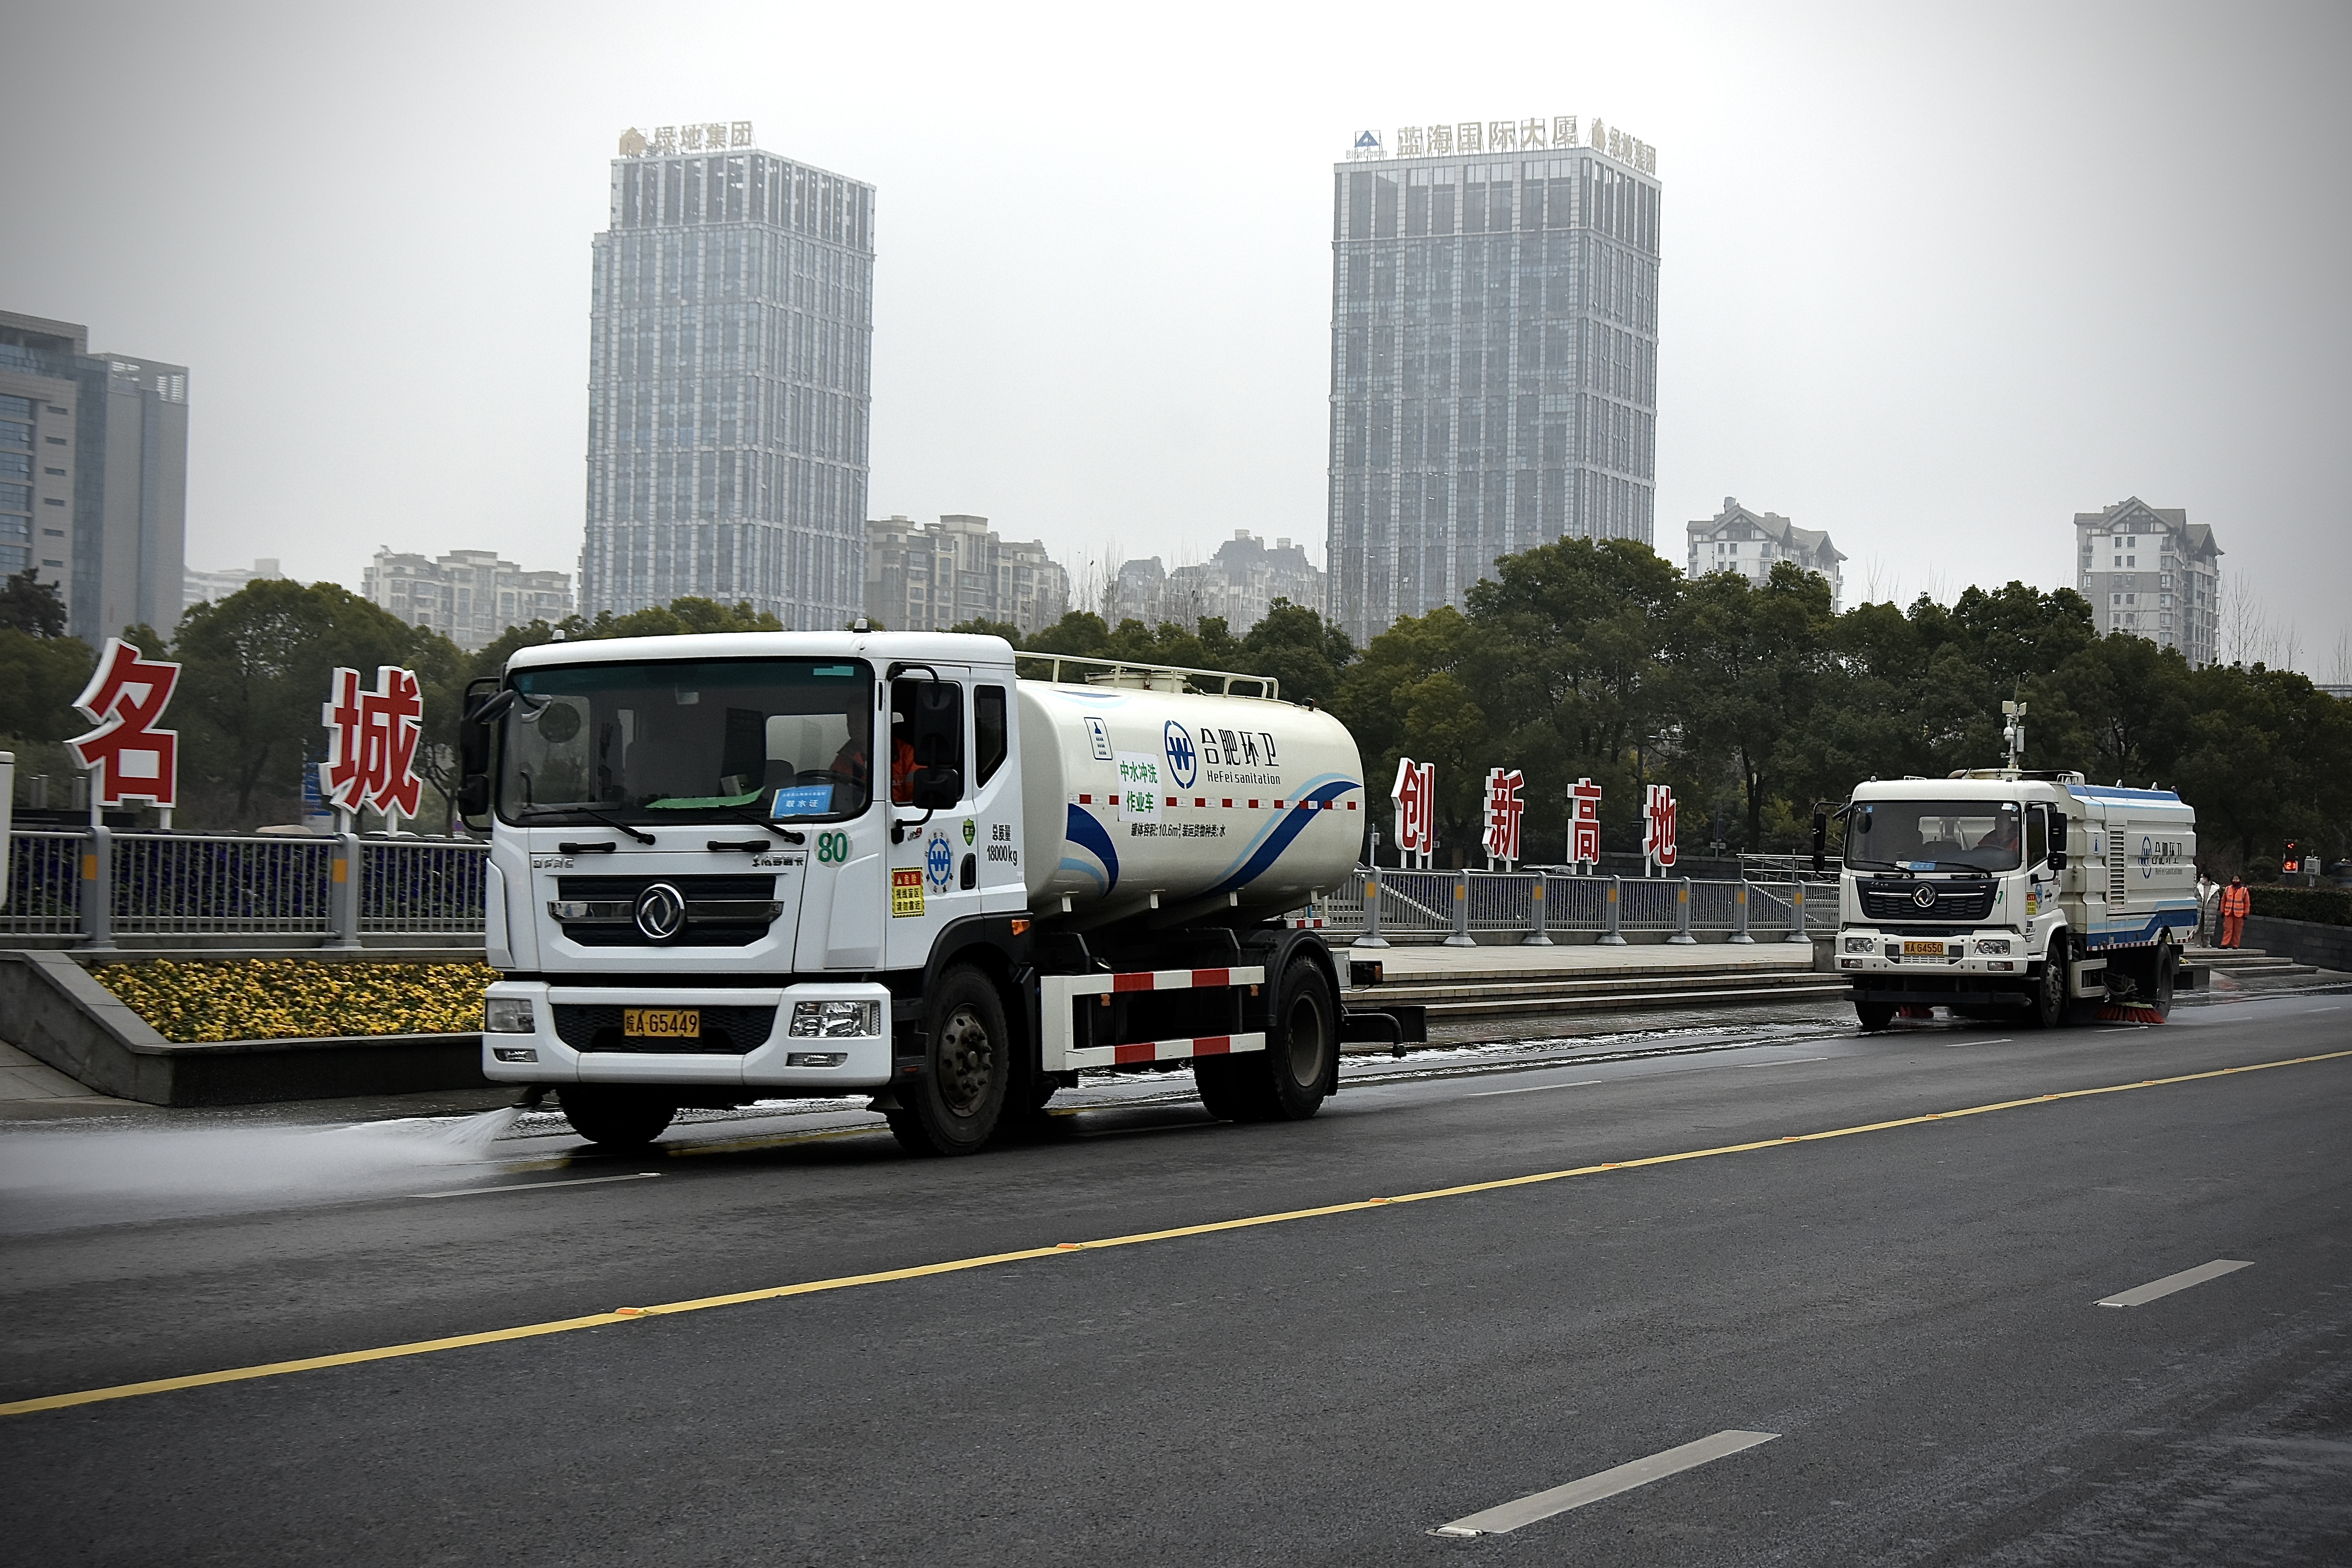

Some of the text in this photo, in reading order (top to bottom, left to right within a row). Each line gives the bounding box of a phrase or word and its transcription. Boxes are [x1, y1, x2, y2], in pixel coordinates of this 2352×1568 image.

[654, 120, 752, 153] 绿地集团
[1397, 115, 1577, 156] 蓝海国际大厦
[1200, 728, 1279, 767] 合肥环卫
[1120, 760, 1158, 784] 中水冲洗
[1207, 770, 1281, 785] HeFei sanitation
[1126, 790, 1154, 813] 作业车
[818, 832, 848, 863] 80
[987, 845, 1018, 866] 18000kg
[2285, 862, 2297, 870] 21
